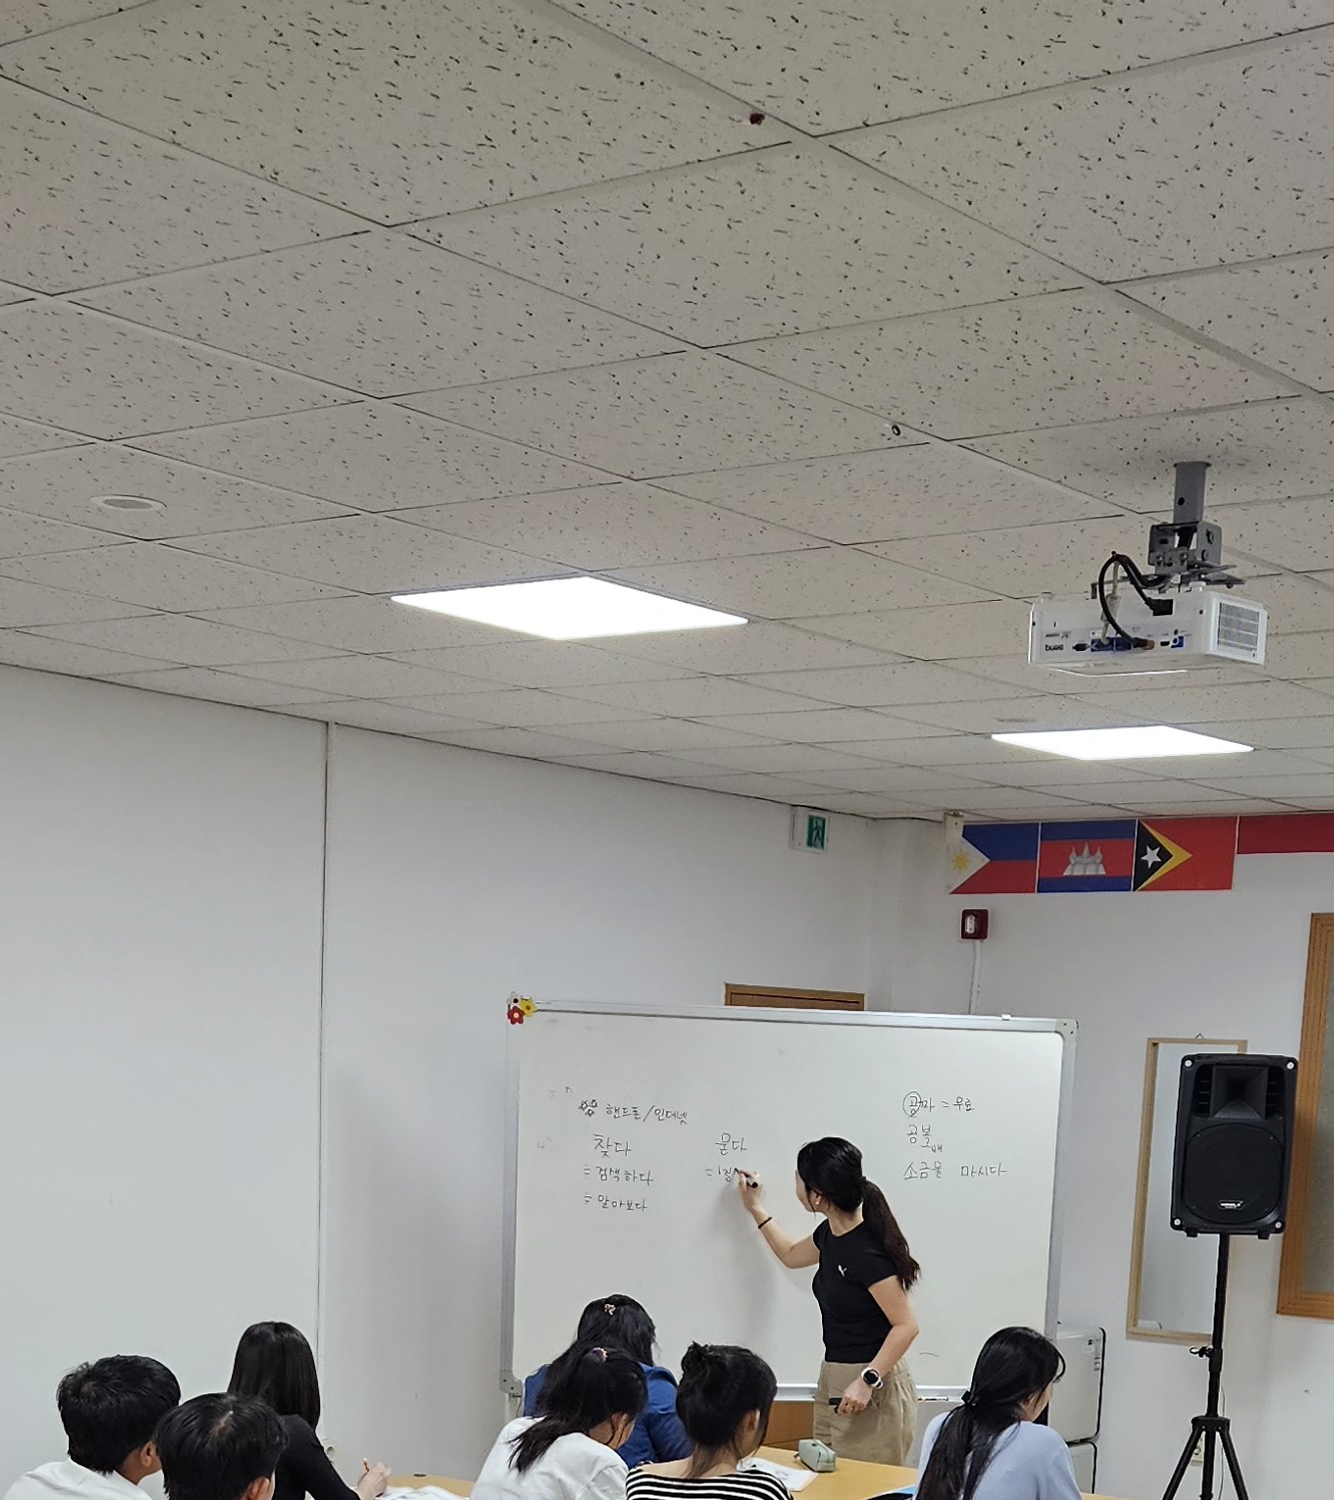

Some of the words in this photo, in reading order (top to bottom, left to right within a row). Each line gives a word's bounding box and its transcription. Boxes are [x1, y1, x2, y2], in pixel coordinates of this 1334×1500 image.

[593, 1133, 632, 1158] 찾다
[596, 1165, 654, 1186] 검색하다
[960, 1162, 1008, 1178] 마시다
